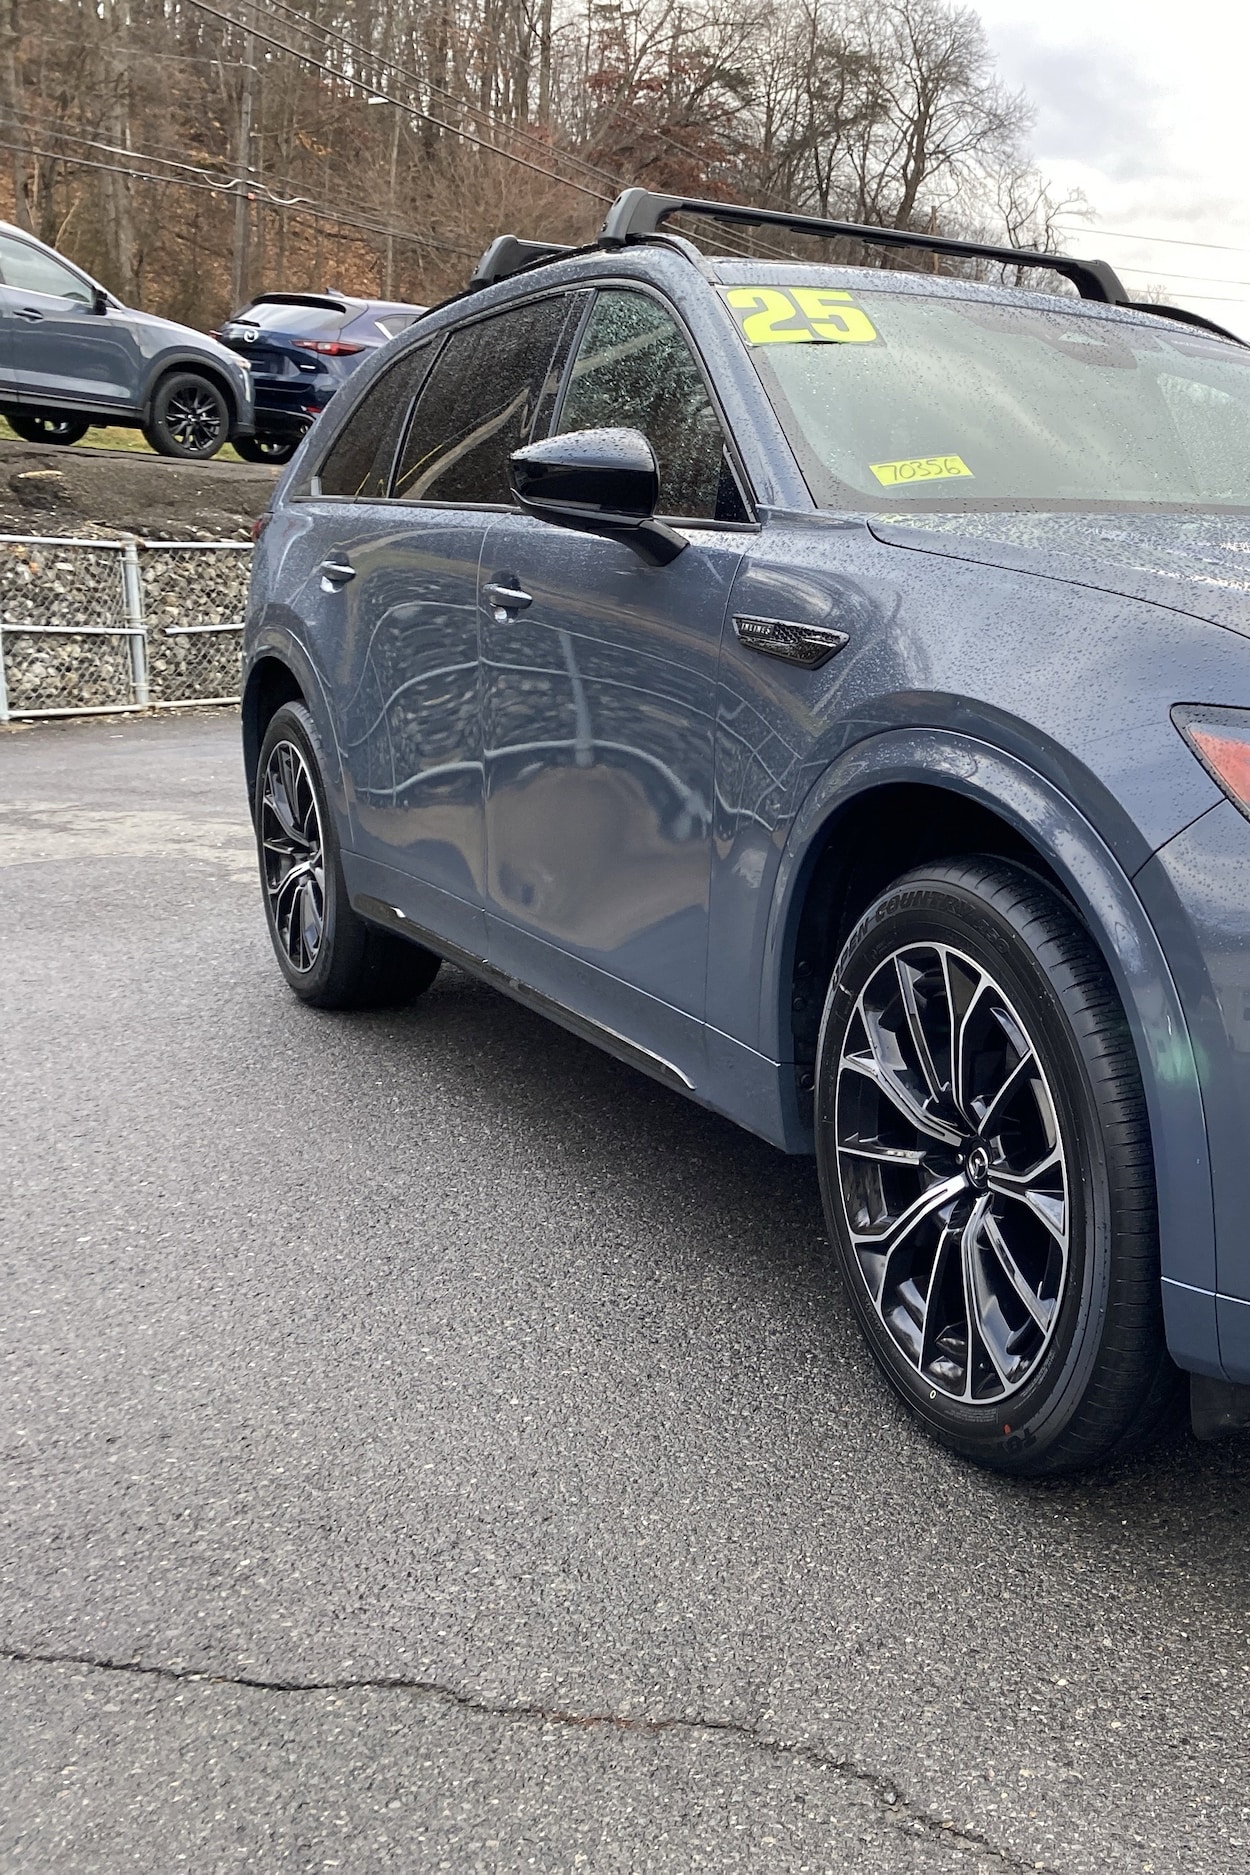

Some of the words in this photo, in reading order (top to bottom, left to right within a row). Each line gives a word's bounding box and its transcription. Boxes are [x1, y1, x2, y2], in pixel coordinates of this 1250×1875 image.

[726, 288, 877, 343] 25
[878, 458, 961, 481] 70356
[875, 890, 977, 922] COUNTRY
